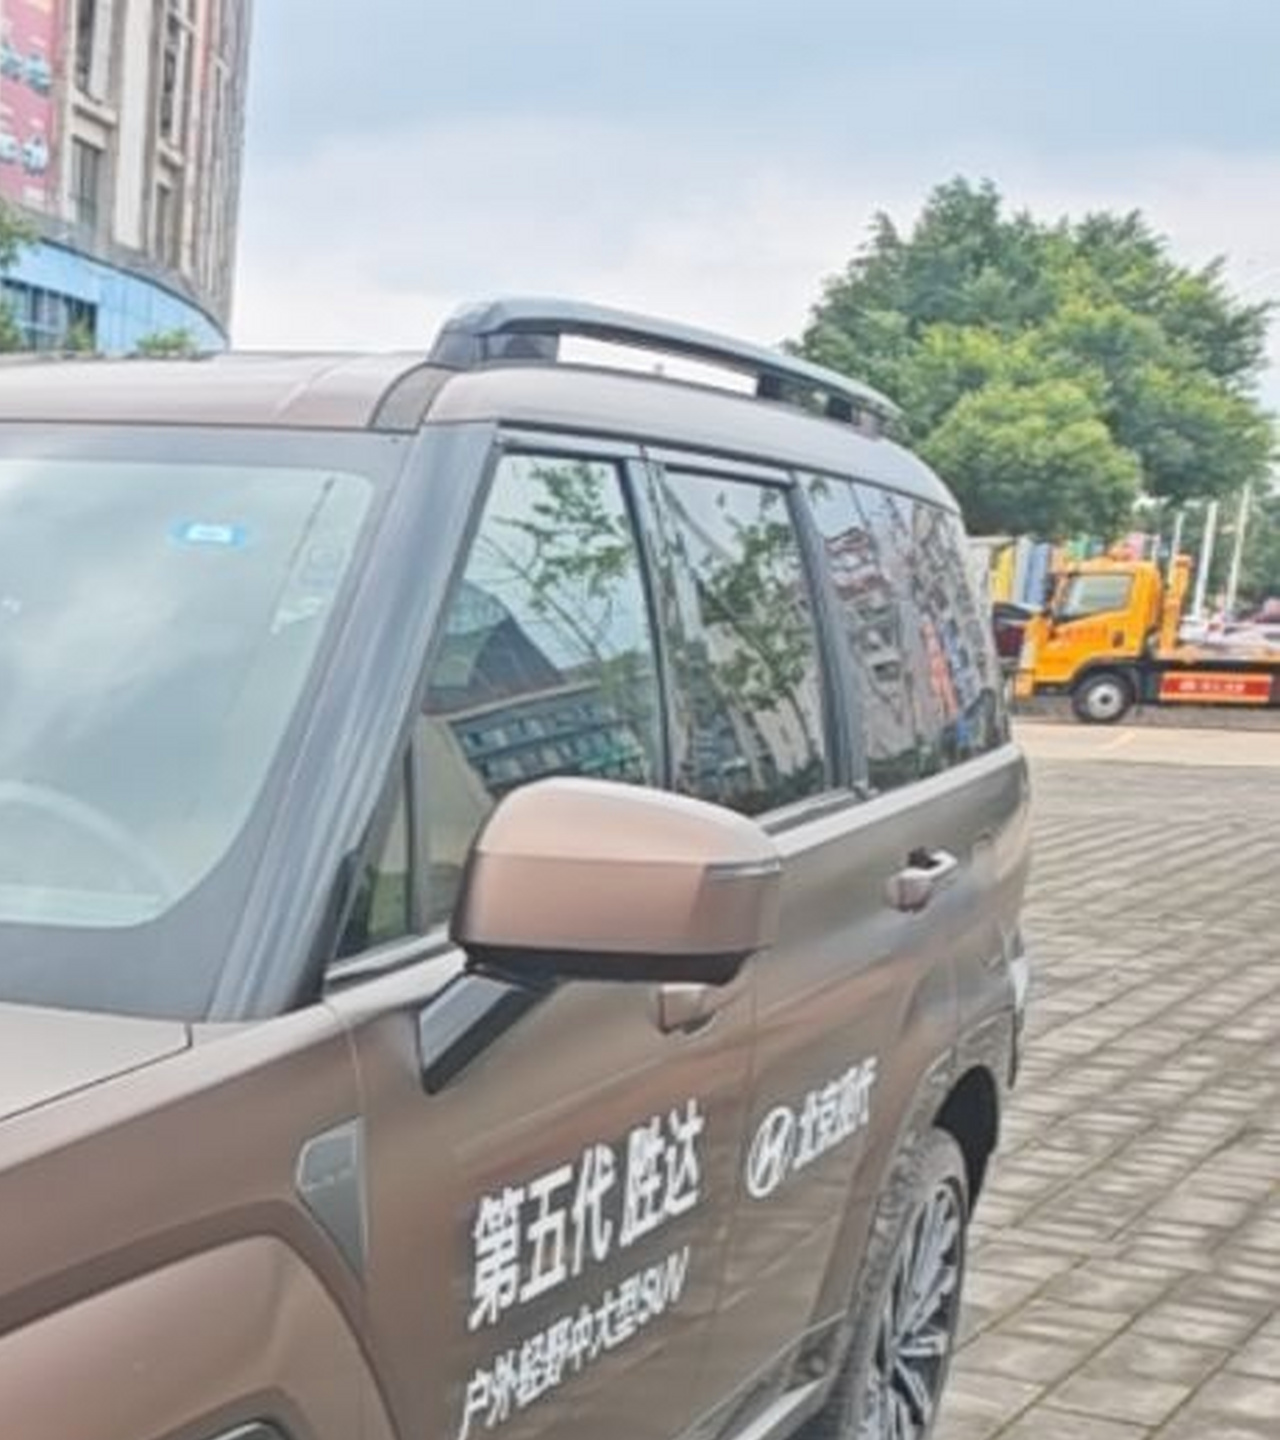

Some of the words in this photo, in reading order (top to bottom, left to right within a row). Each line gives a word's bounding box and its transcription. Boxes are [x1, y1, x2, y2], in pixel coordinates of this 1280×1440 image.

[469, 1143, 617, 1332] 第五代
[619, 1099, 705, 1248] 胜达
